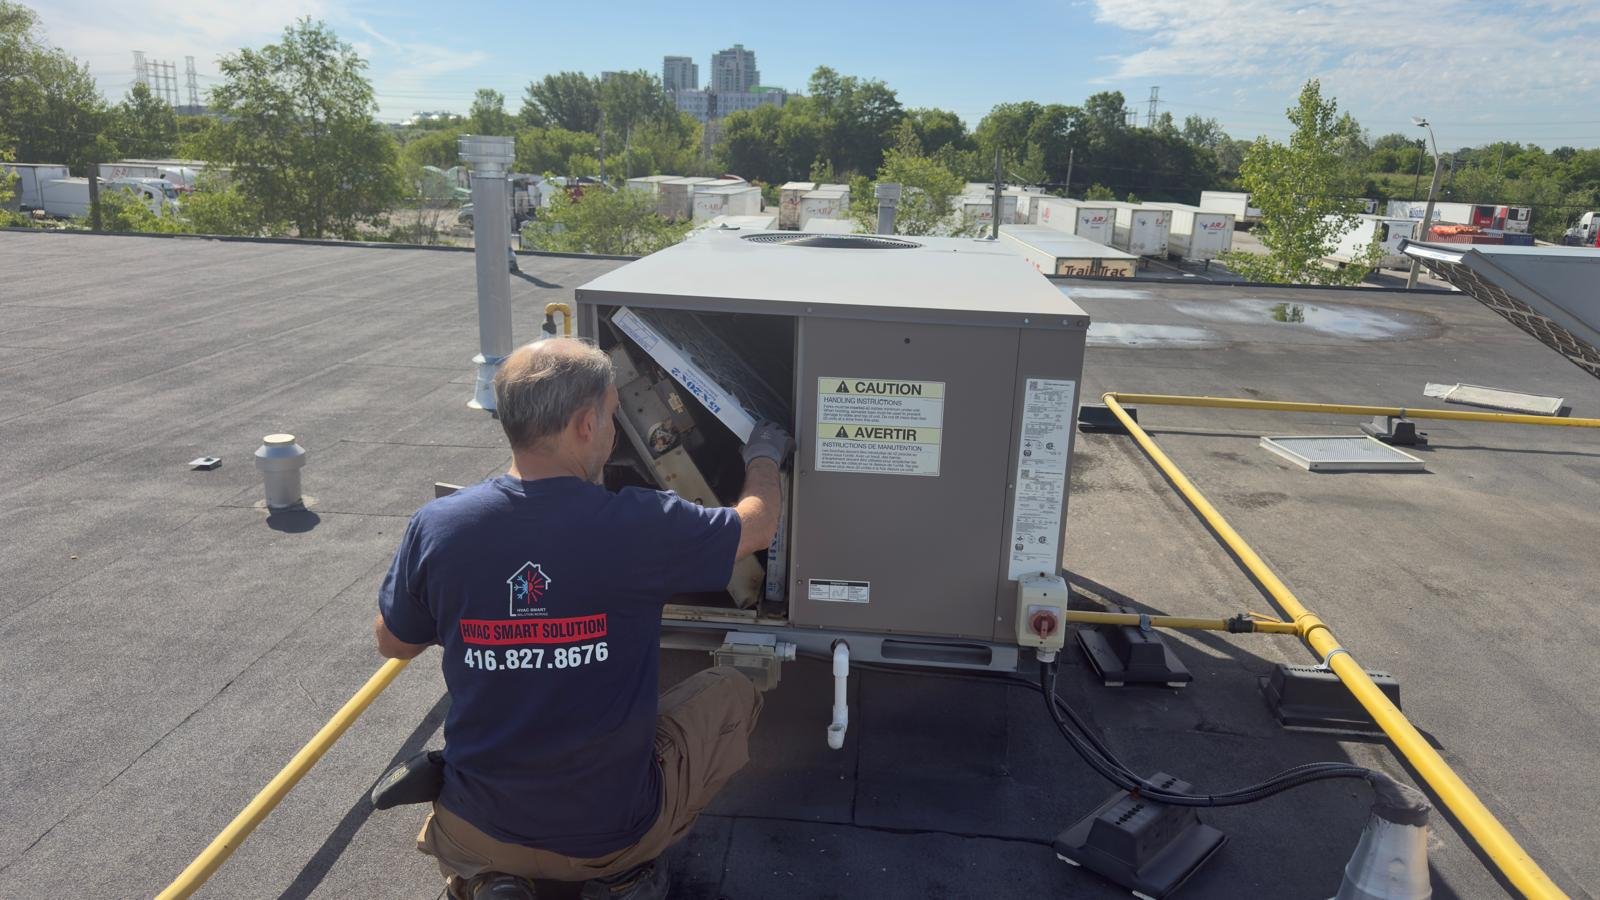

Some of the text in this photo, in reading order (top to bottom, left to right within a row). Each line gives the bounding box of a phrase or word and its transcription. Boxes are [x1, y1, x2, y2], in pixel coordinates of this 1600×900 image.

[855, 382, 922, 395] CAUTION
[823, 396, 903, 406] HANDLING INSTRUCTIONS
[854, 426, 917, 441] AVERTIR
[822, 441, 867, 450] INSTRUCTIONS
[877, 443, 922, 452] MANUTENTION
[461, 617, 605, 640] HVAC SMART SOLUTION
[464, 641, 609, 671] 416.827.8676
